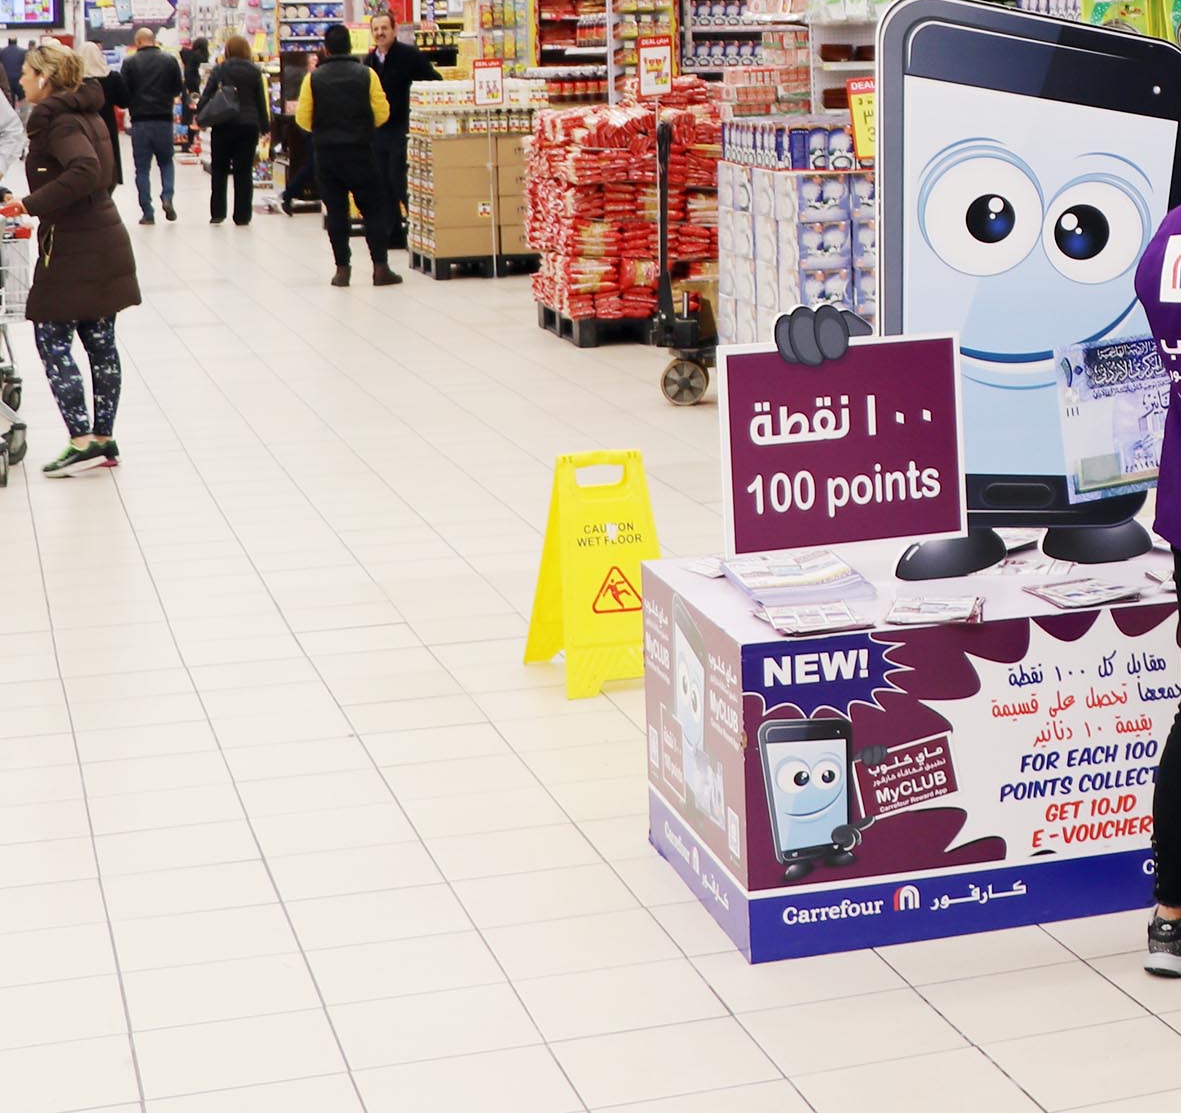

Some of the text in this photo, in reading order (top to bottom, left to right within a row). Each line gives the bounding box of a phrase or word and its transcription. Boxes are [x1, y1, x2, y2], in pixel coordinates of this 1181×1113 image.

[750, 394, 932, 446] ١٠٠ نقطة
[747, 460, 941, 518] 100 points
[577, 537, 601, 547] WET
[763, 648, 870, 688] NEW!
[1008, 663, 1044, 688] نقطة
[1098, 649, 1117, 678] كل
[1127, 652, 1167, 679] مقابل
[991, 683, 1128, 722] تحصل على قسيمة
[1032, 714, 1153, 748] بقيمة دنانير
[1020, 740, 1159, 773] FOR EACH 100
[875, 771, 948, 804] MyCLUB
[999, 776, 1072, 802] POINTS
[1045, 799, 1084, 822] GET
[782, 896, 884, 925] Carrefour
[930, 880, 1027, 911] كارفور
